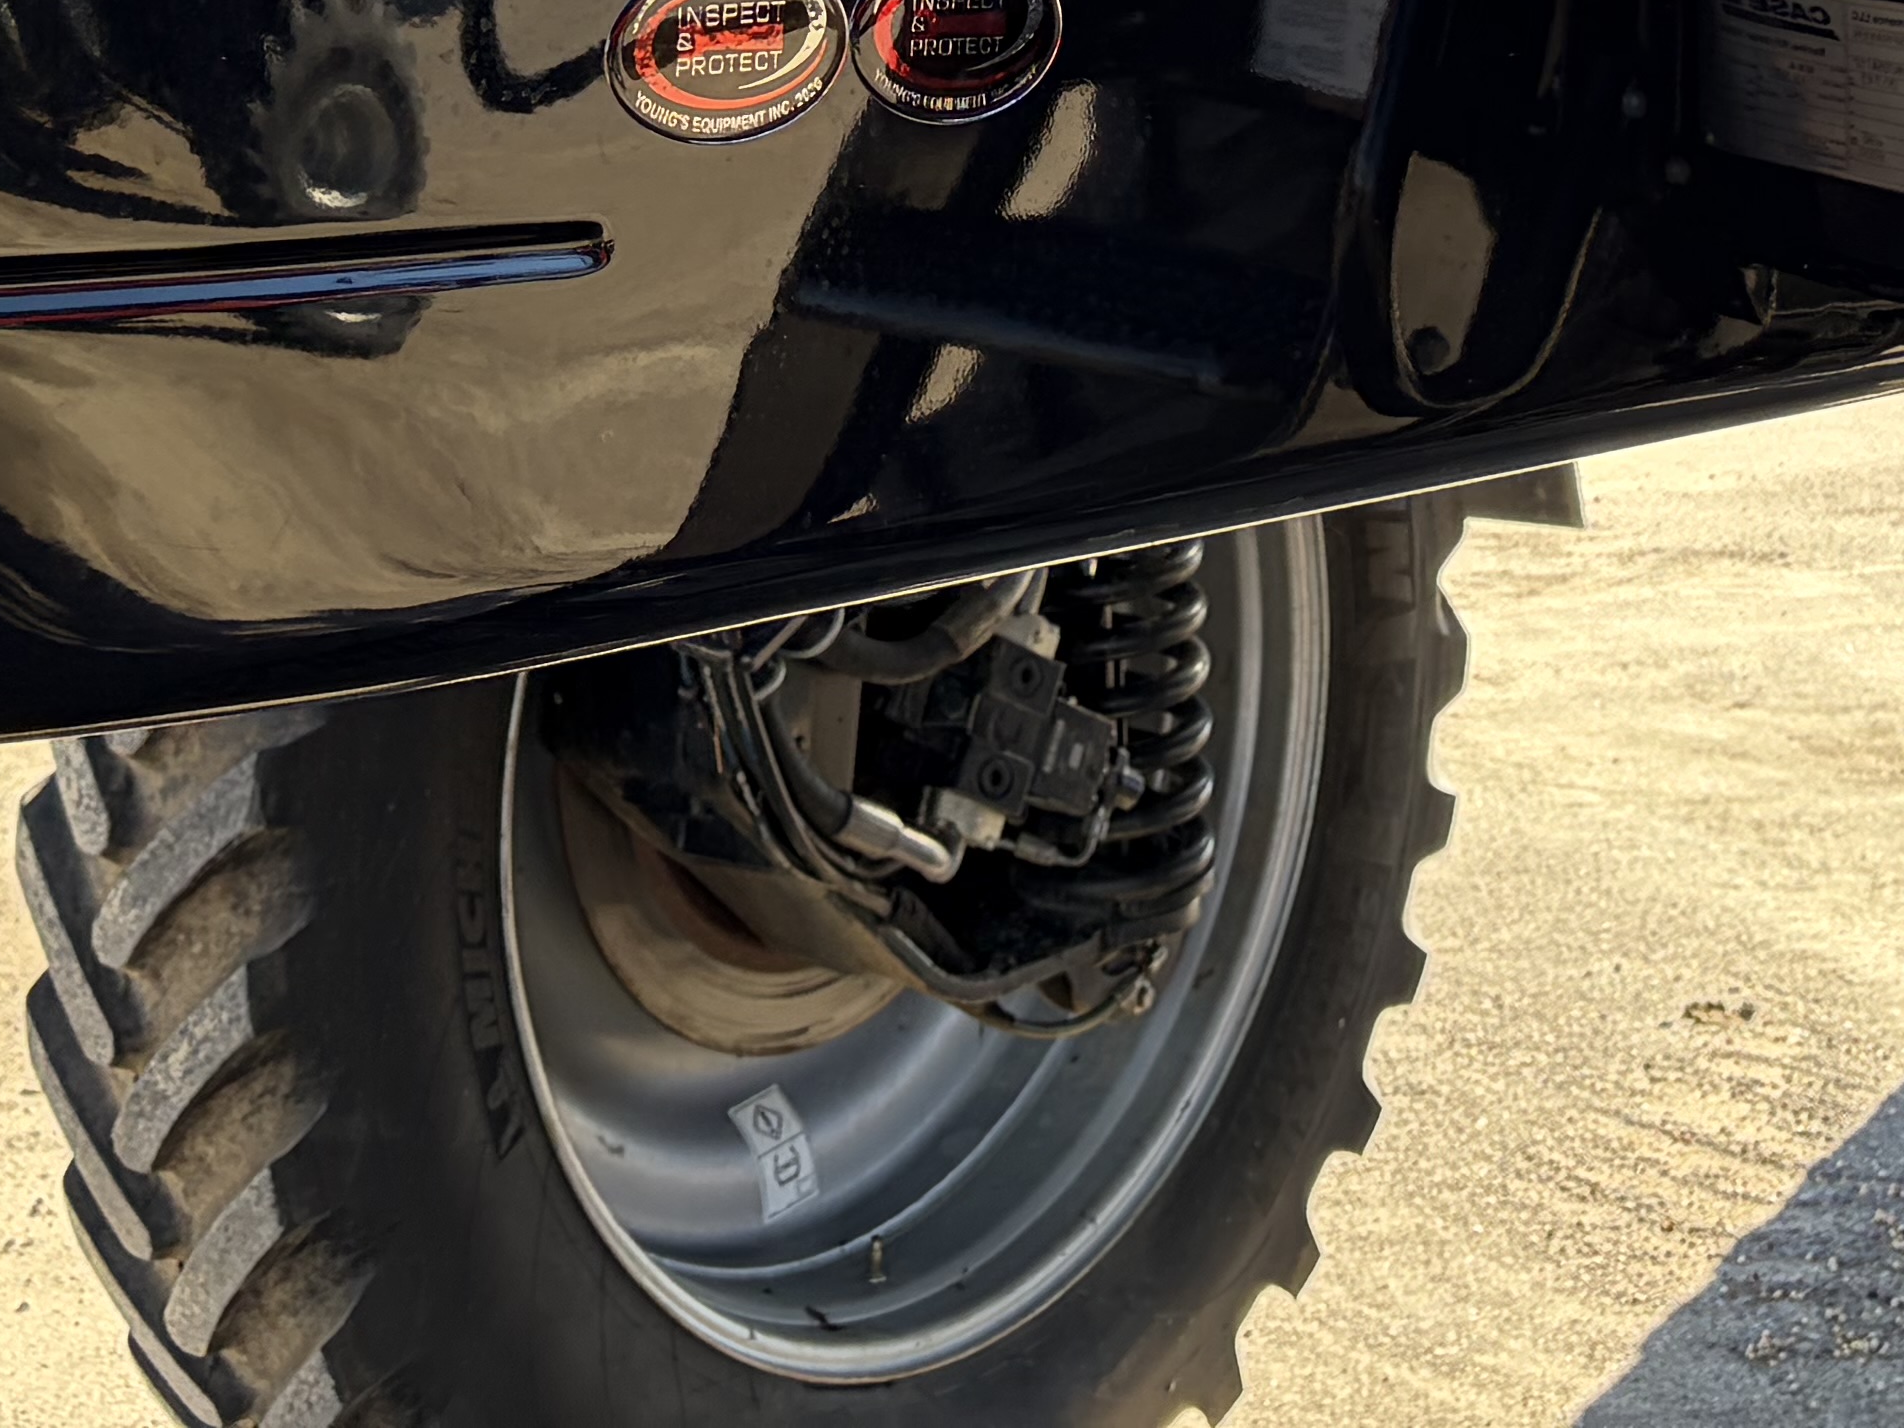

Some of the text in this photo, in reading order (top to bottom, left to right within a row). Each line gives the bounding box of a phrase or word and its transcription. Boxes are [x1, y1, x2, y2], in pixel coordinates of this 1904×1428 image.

[678, 0, 786, 29] INSPECT
[911, 15, 926, 33] &
[676, 32, 694, 51] &
[910, 36, 1004, 57] PROTECT
[675, 50, 783, 78] PROTECT
[634, 90, 690, 132] YOUNG'S
[692, 110, 766, 134] EQUIPMENT
